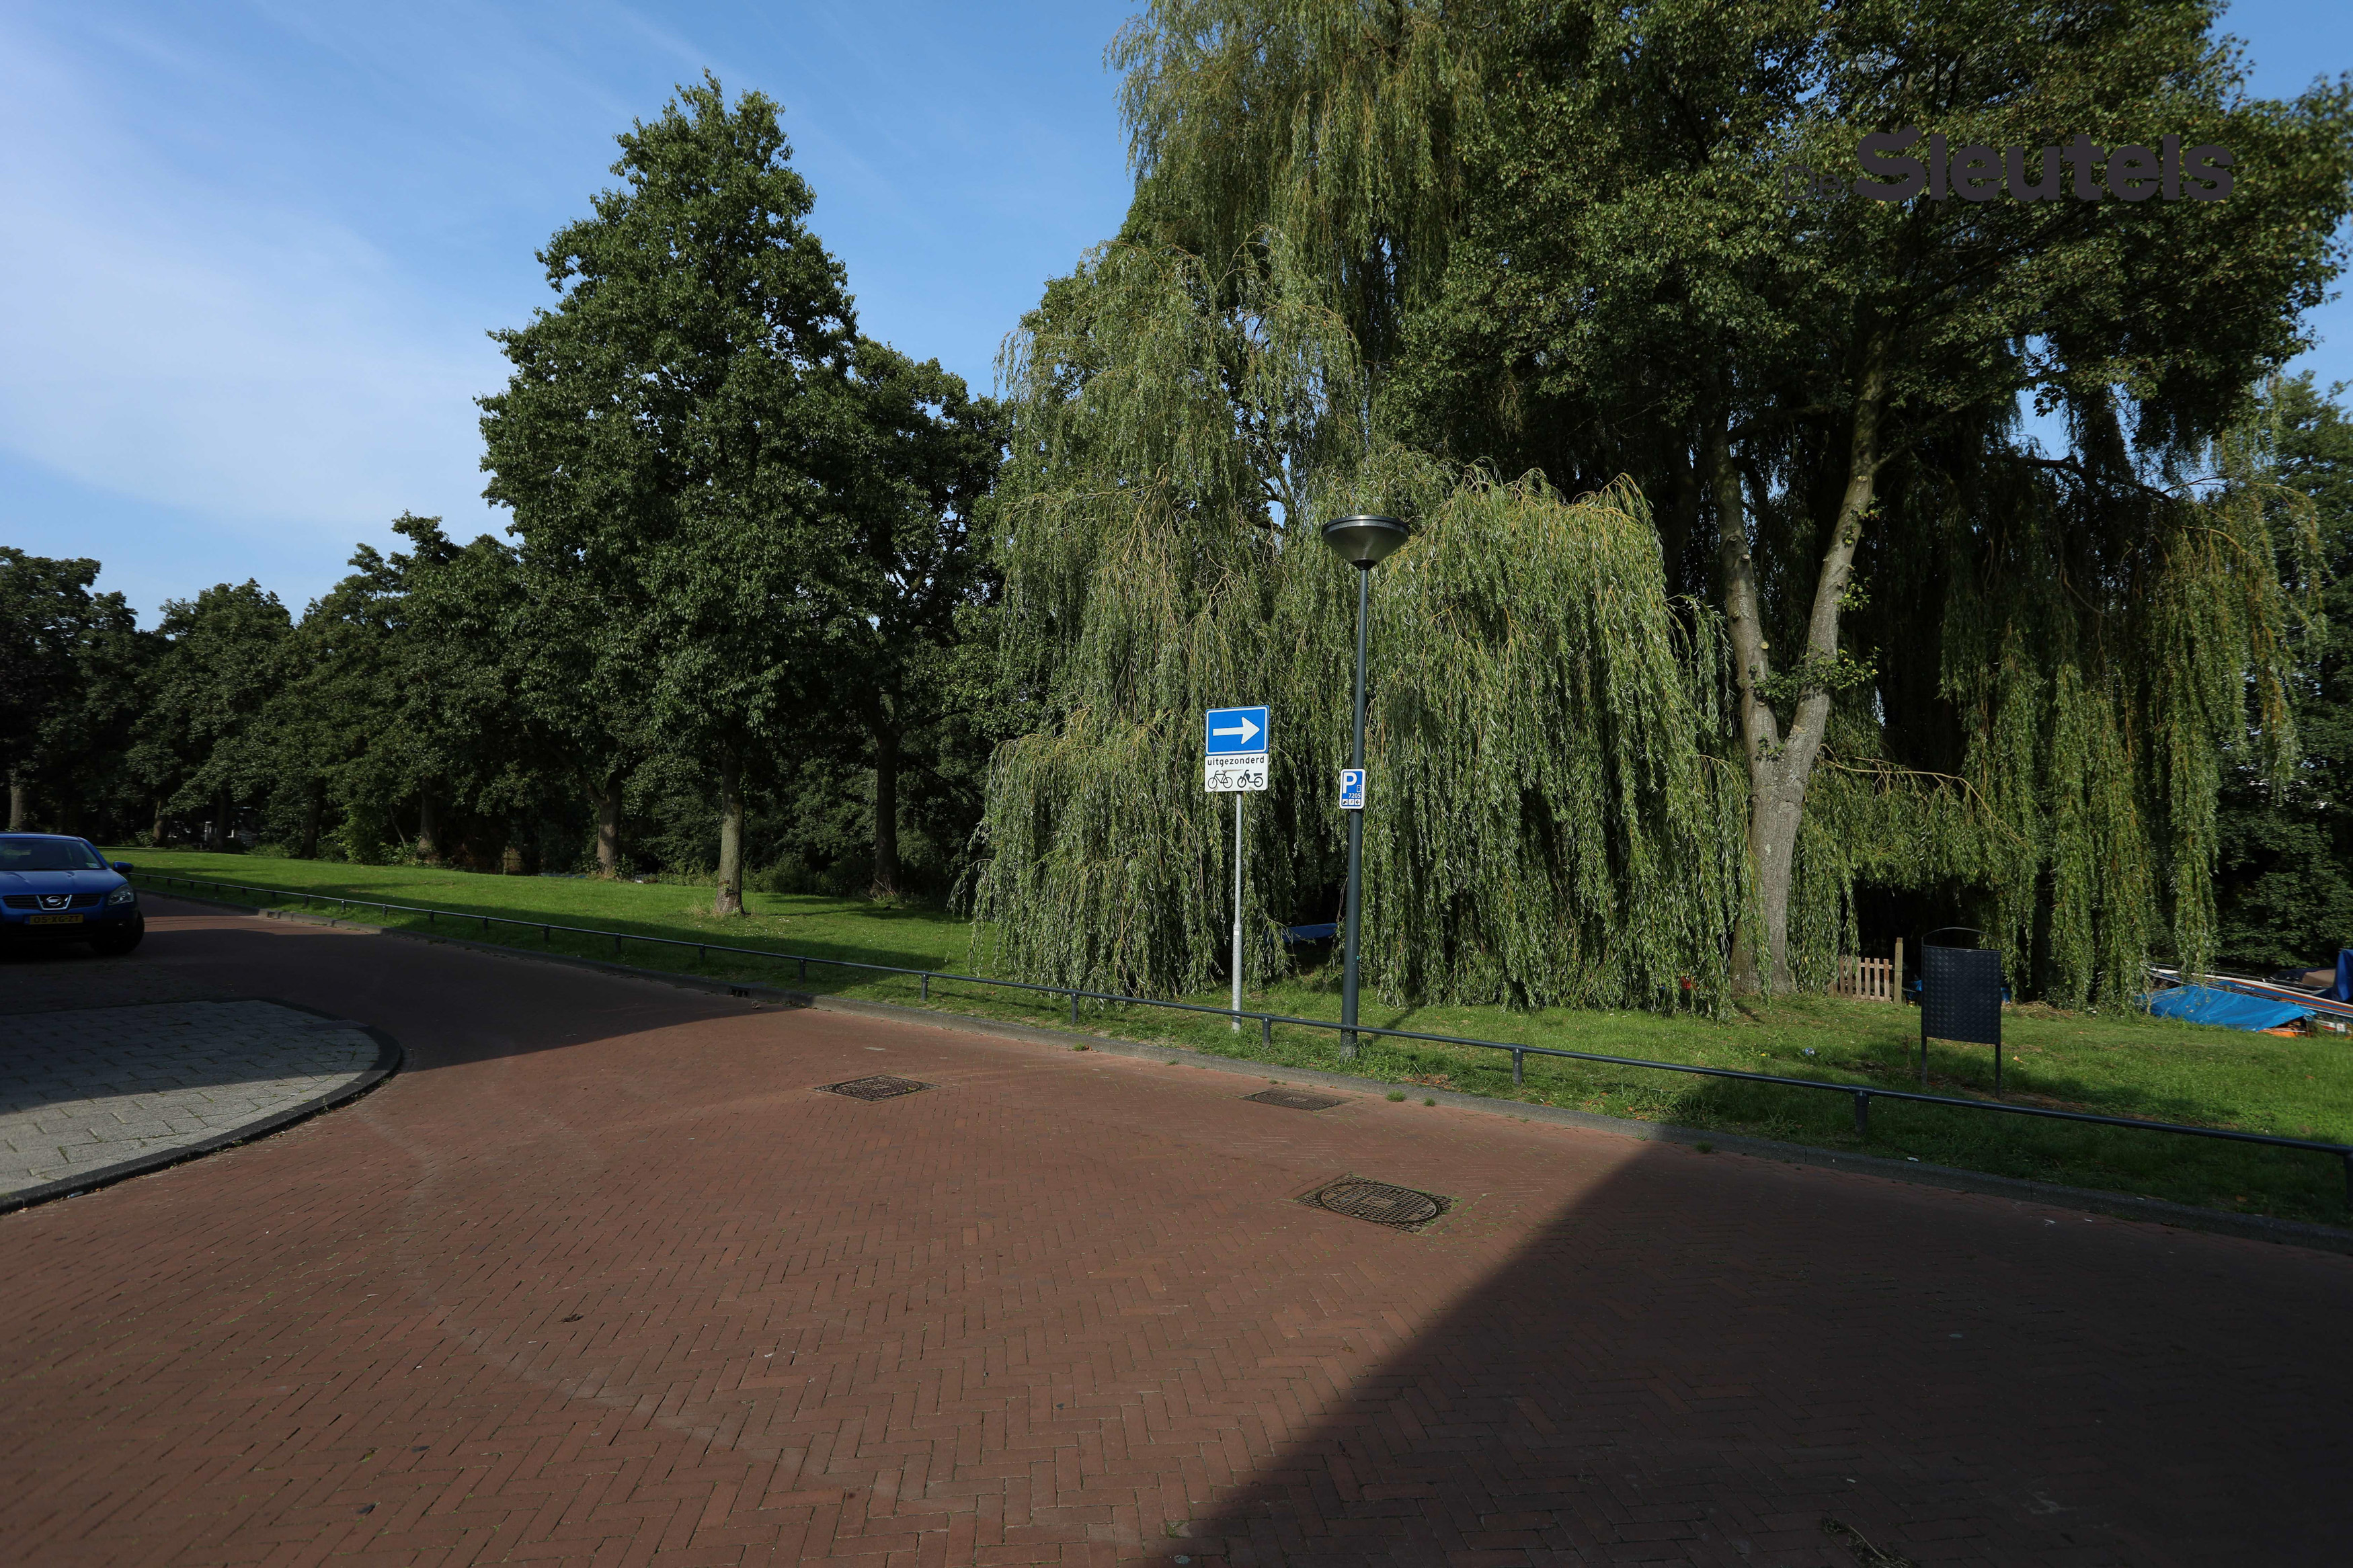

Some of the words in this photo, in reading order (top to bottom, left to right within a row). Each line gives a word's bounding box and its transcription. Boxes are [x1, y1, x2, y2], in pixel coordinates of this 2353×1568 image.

[1207, 755, 1265, 768] uitgezonderd
[1343, 772, 1357, 794] P
[34, 915, 79, 923] 05-XG-ZT
